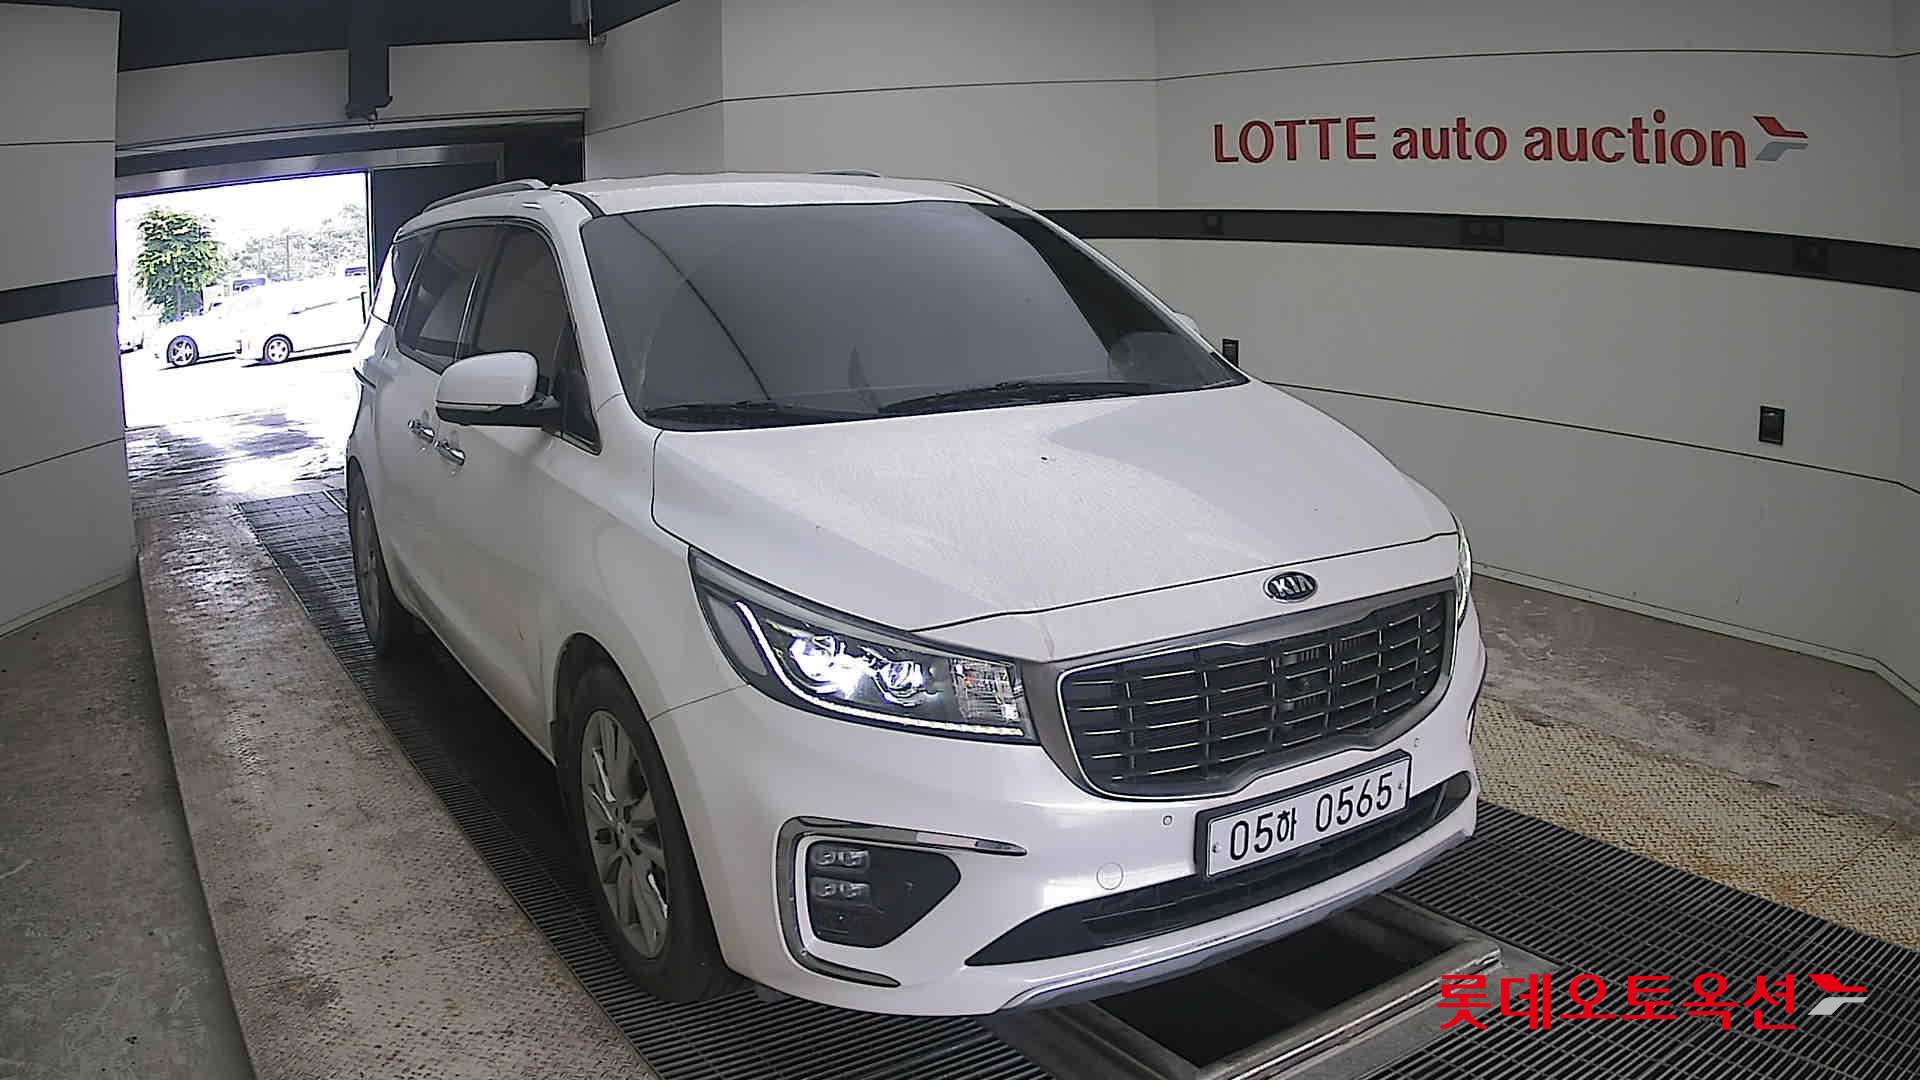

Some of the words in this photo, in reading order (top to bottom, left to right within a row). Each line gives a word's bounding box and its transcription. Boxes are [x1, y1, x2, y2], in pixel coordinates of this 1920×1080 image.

[1213, 116, 1377, 164] LOTTE
[1392, 117, 1507, 161] auto
[1524, 109, 1747, 169] auction
[1268, 574, 1314, 598] KIA
[1230, 807, 1297, 860] 05하
[1315, 771, 1393, 832] 0565
